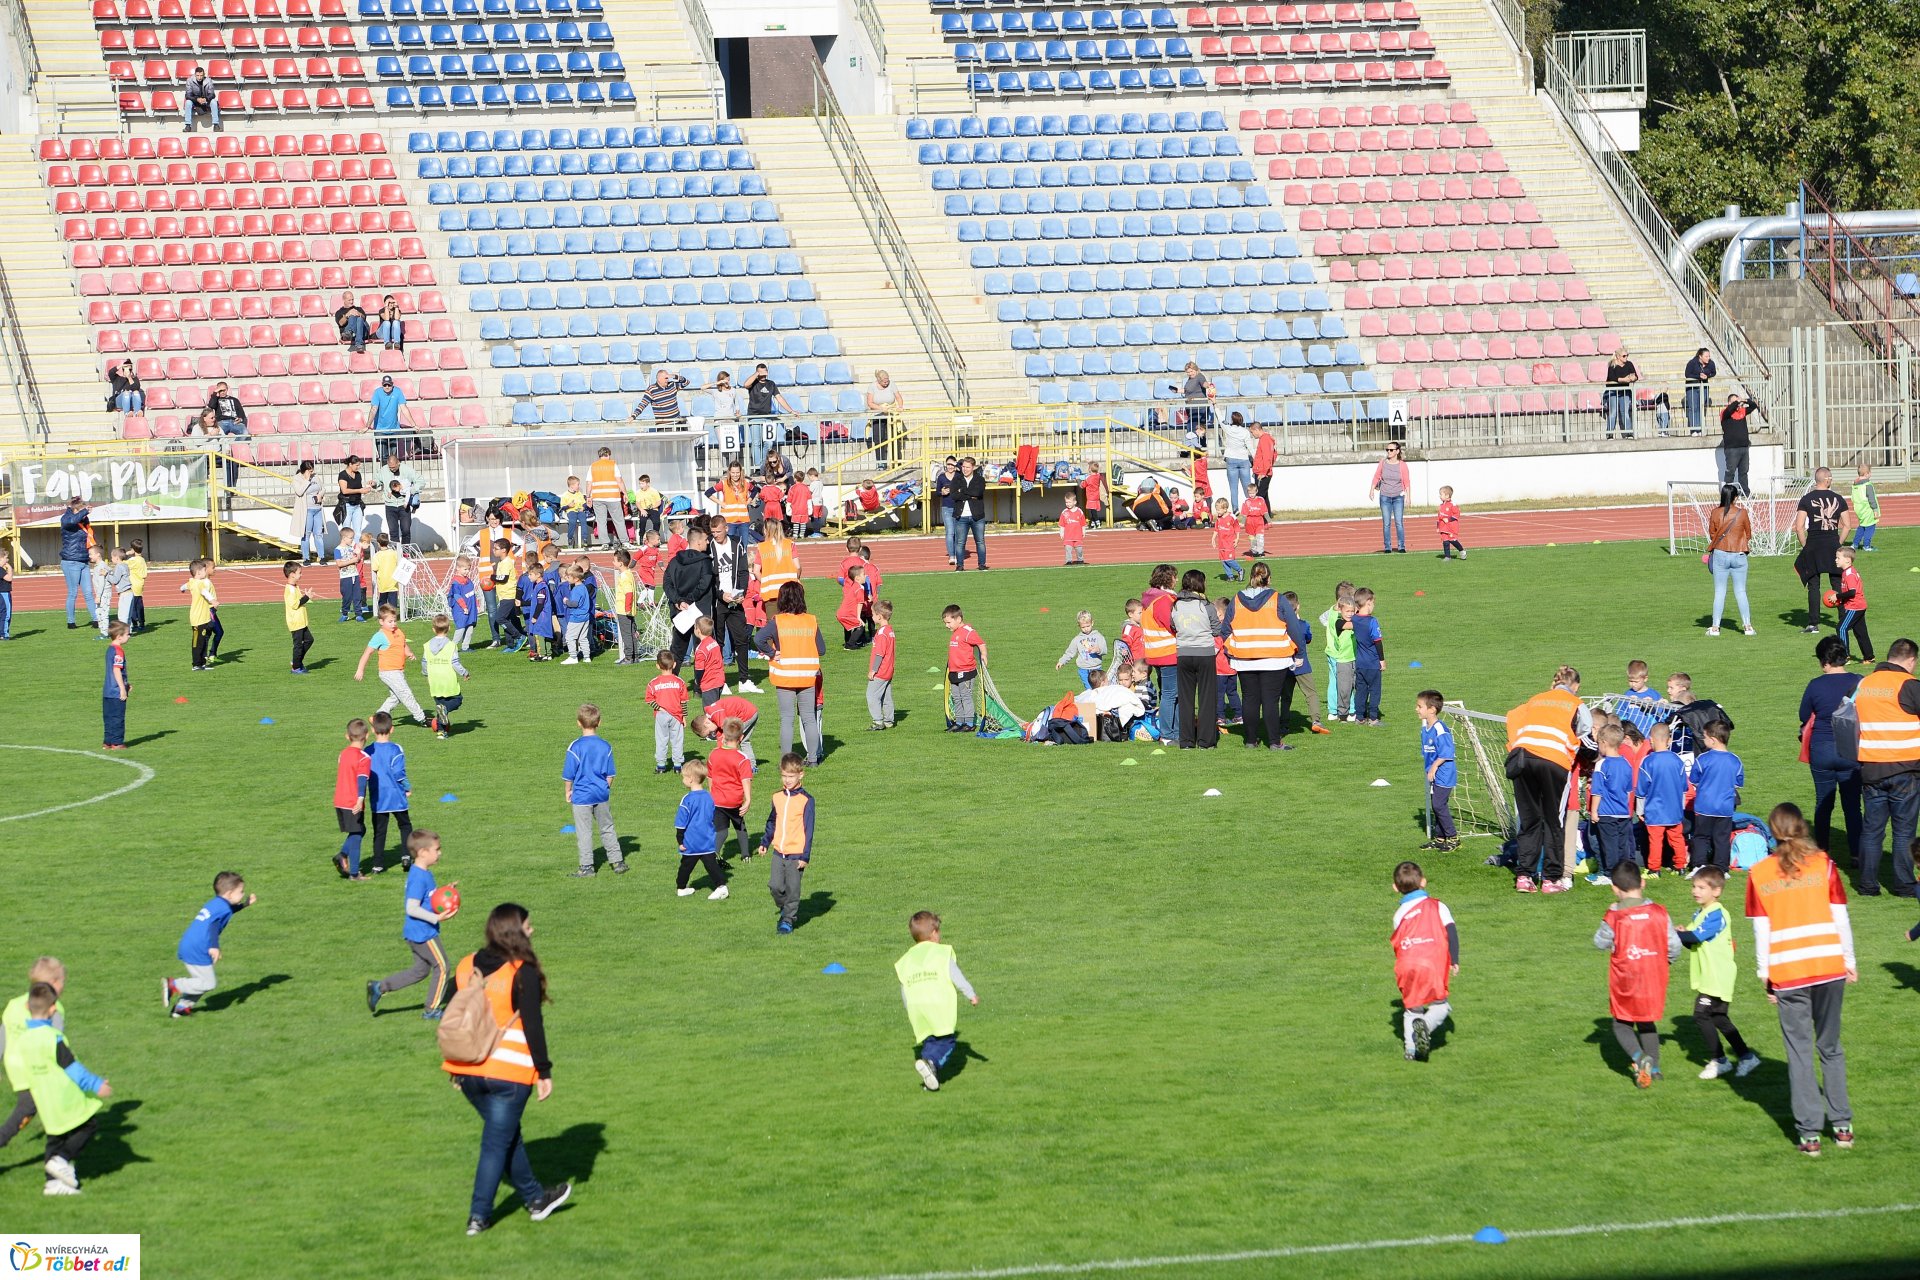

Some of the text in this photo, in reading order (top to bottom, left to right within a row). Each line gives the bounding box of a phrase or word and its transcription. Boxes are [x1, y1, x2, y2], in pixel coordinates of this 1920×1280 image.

[1393, 410, 1403, 422] A
[766, 424, 774, 440] B
[725, 436, 735, 449] B
[21, 461, 189, 504] Fair Play
[401, 563, 411, 572] 18
